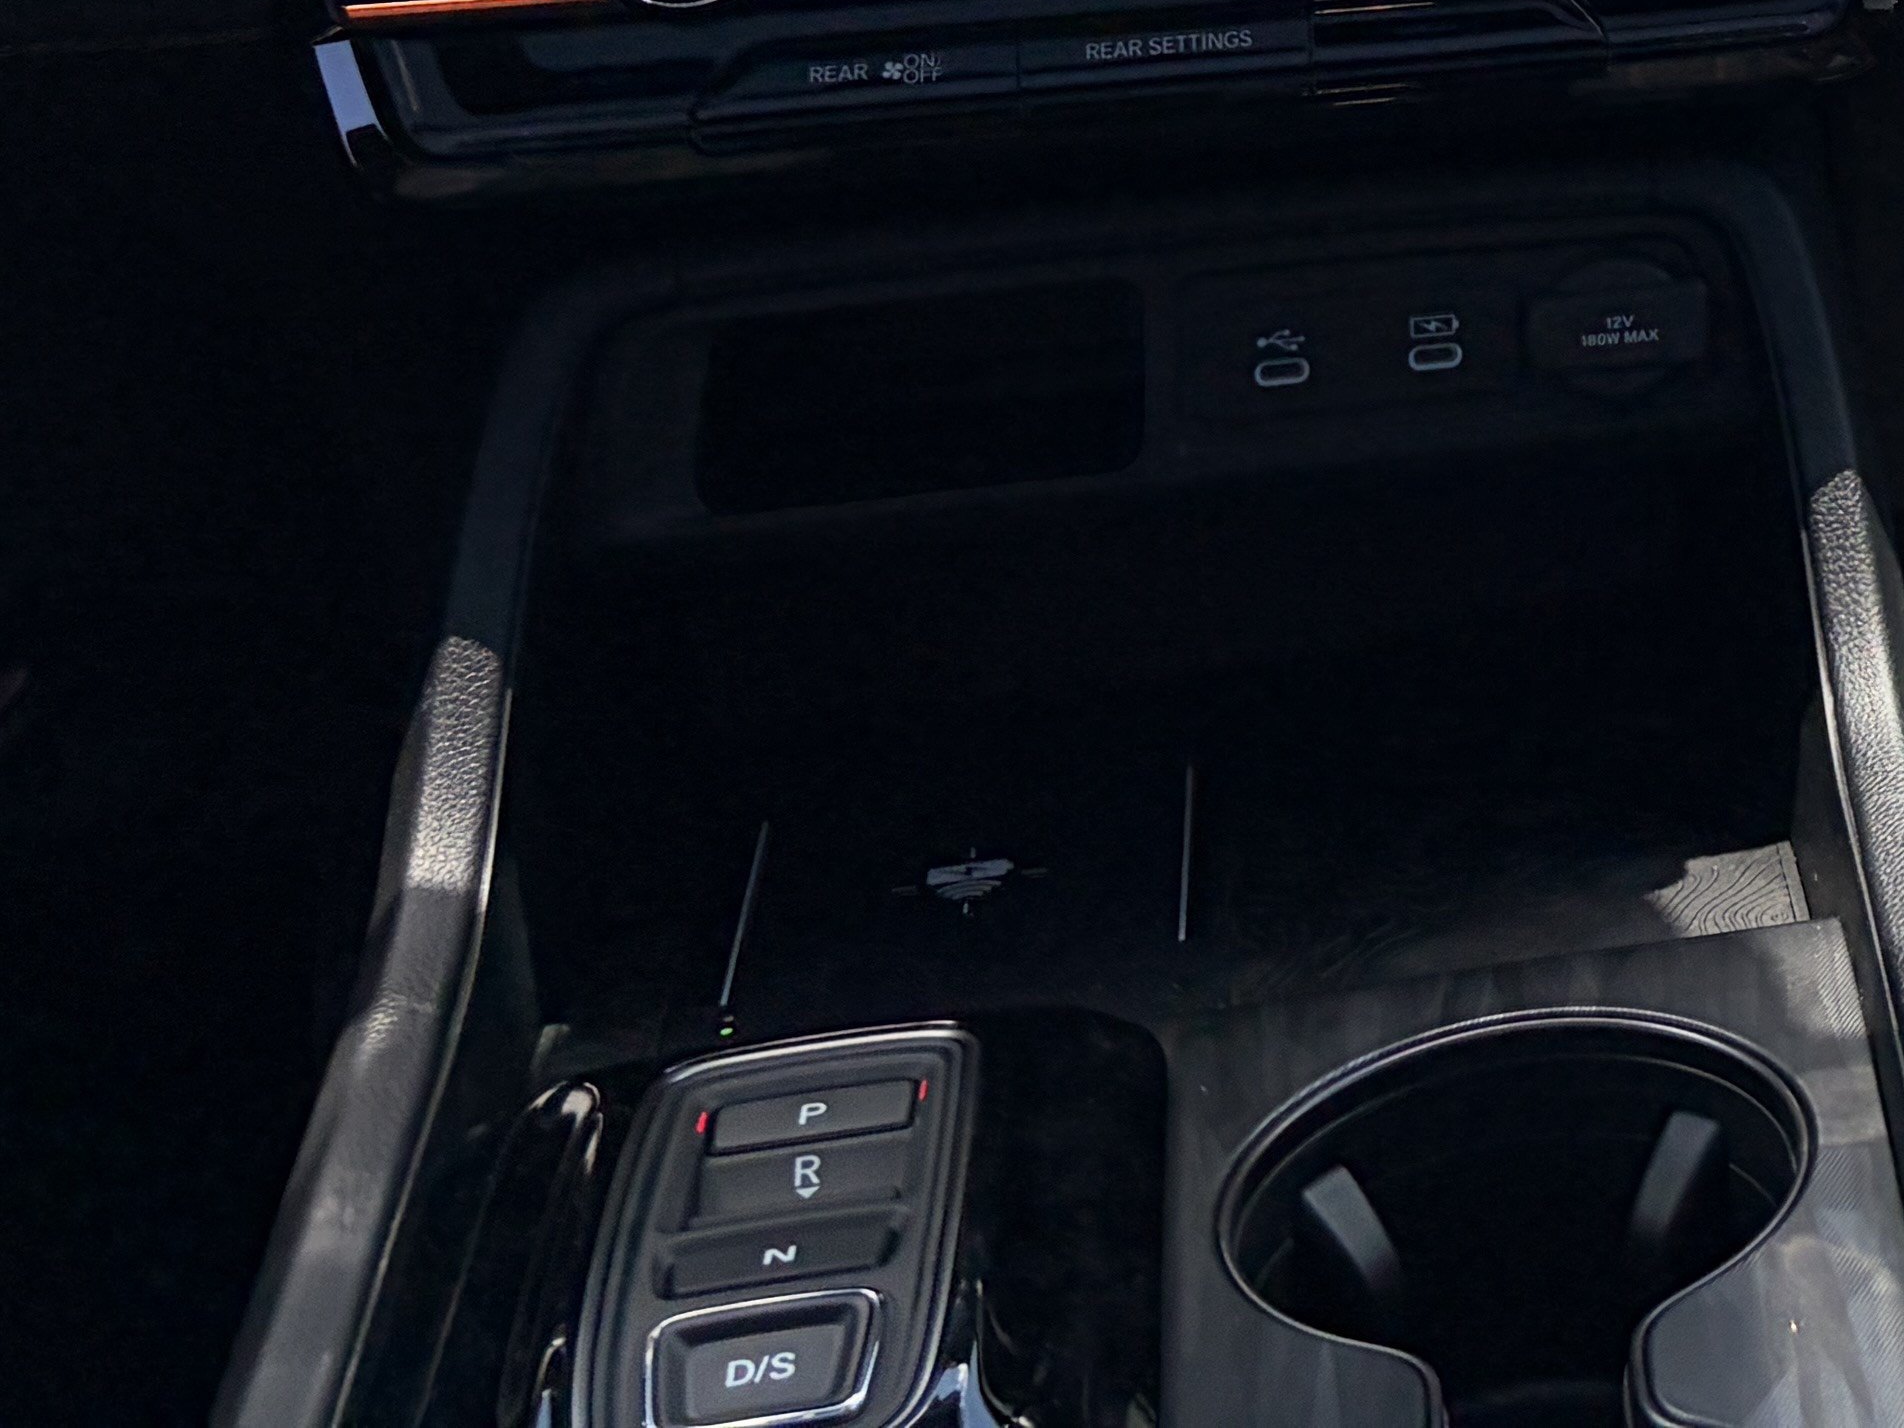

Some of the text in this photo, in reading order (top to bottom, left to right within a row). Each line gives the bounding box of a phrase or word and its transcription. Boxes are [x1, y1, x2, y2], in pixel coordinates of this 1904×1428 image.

[1084, 29, 1254, 61] REAR SETTINGS
[809, 61, 869, 85] REAR
[902, 66, 944, 85] OFF
[1605, 314, 1636, 330] 12V
[1581, 328, 1660, 348] 180W MAX
[798, 1102, 827, 1126] P
[793, 1155, 822, 1187] R
[761, 1245, 797, 1266] N
[723, 1351, 797, 1389] D/S
